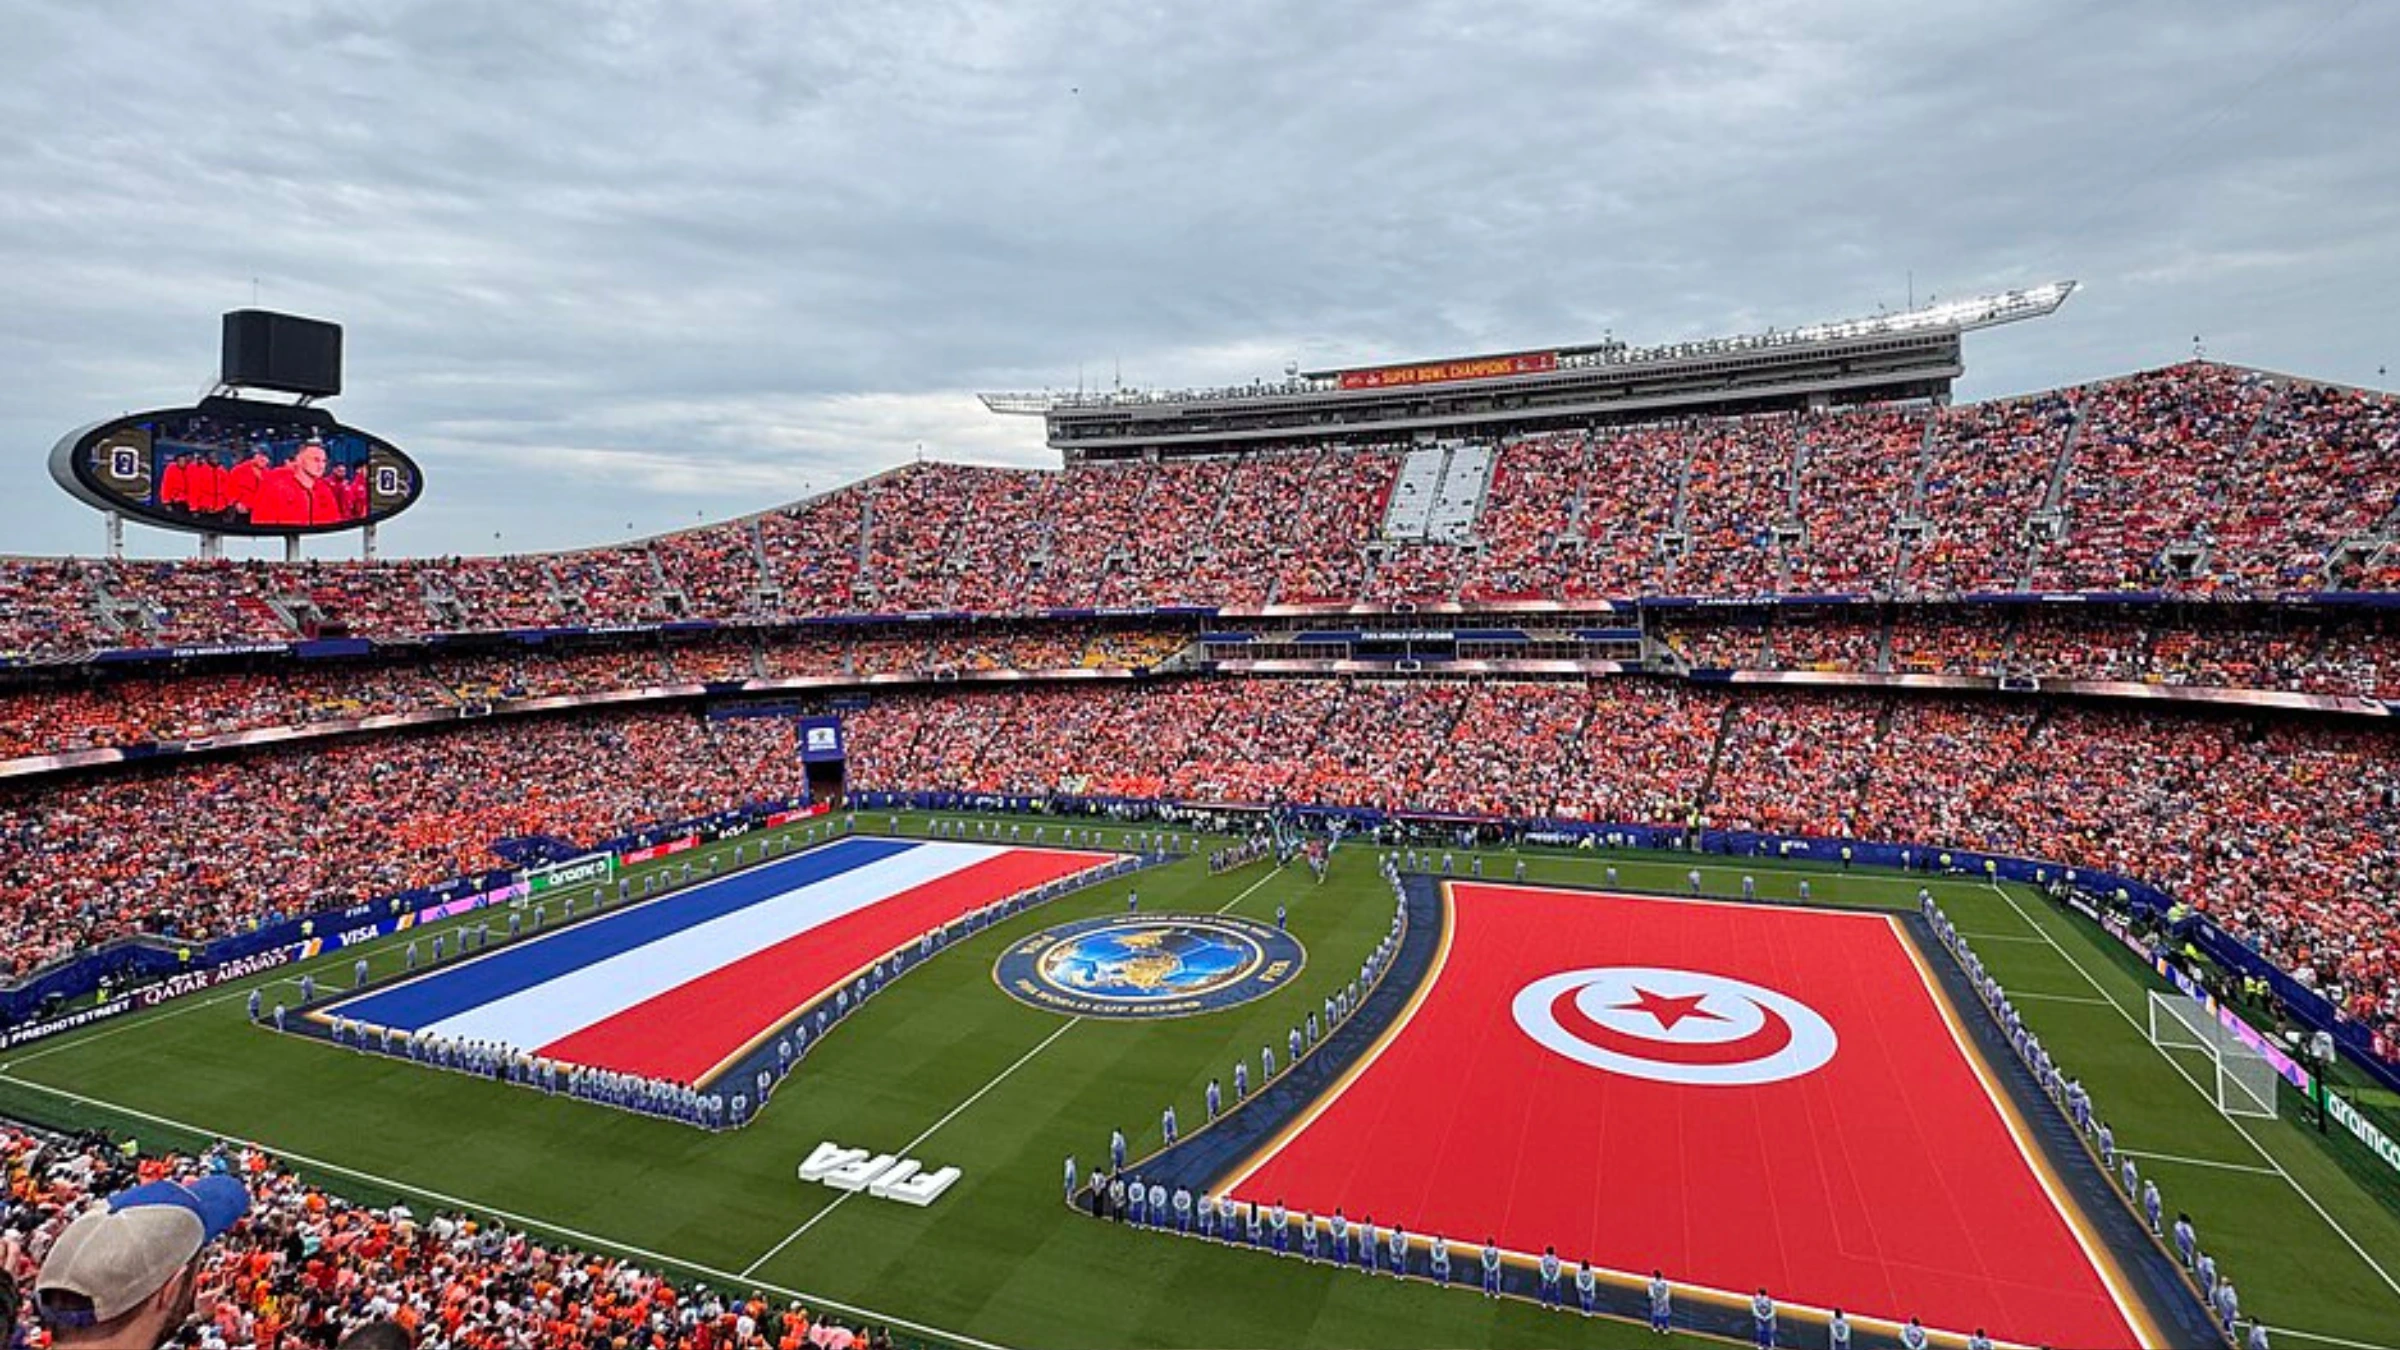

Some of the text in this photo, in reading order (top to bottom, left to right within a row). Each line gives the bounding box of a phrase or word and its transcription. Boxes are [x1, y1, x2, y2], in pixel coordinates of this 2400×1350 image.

[1382, 359, 1510, 384] SUPER BOWL CHAMPIONS
[549, 860, 607, 886] aramco
[344, 904, 370, 918] FIFA
[339, 924, 379, 946] VISA
[145, 951, 289, 1005] QATAR AIRWAYS
[2328, 1092, 2400, 1172] aramco
[799, 1141, 963, 1207] FIFA
